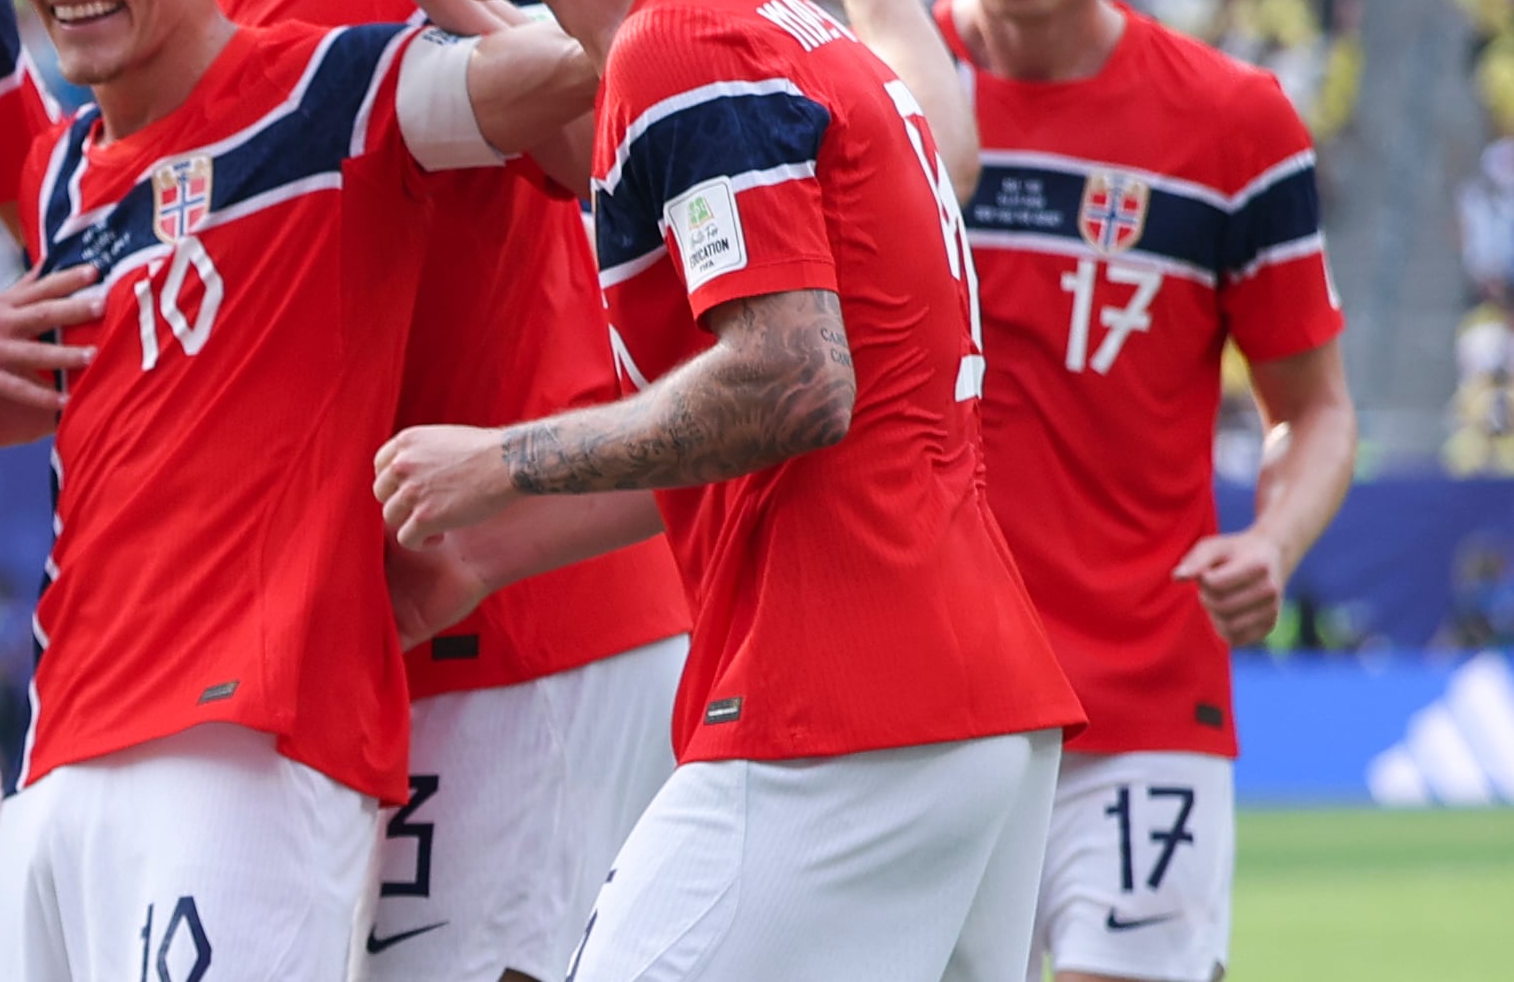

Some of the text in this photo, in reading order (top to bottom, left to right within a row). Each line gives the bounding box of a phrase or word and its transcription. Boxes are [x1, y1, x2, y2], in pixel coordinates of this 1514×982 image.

[133, 234, 225, 373] 10
[1060, 257, 1164, 376] 17
[380, 774, 440, 899] 3
[1105, 785, 1195, 893] 17
[140, 895, 213, 982] 10
